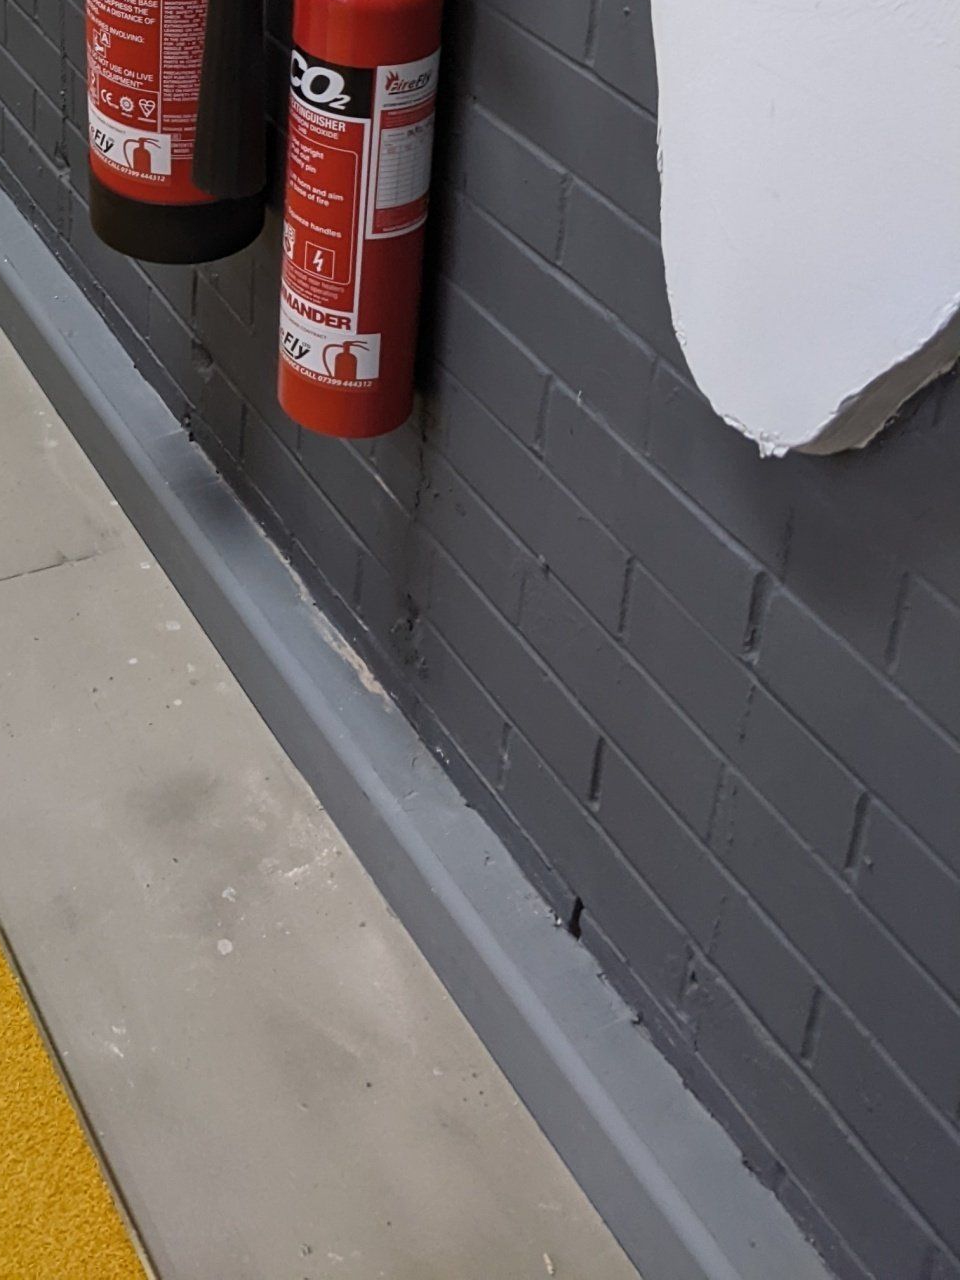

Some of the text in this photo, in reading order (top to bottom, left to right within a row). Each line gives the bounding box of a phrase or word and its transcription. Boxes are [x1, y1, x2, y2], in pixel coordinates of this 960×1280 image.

[111, 9, 143, 23] DISTANCE
[133, 7, 149, 16] THE
[101, 32, 109, 43] A
[110, 63, 123, 74] USE
[123, 68, 135, 78] ON
[136, 72, 154, 82] LIVE
[309, 123, 339, 140] DIOXIDE
[300, 143, 324, 160] upright
[305, 164, 317, 174] pin
[297, 177, 311, 191] horn
[312, 187, 327, 197] and
[328, 192, 344, 202] aim
[307, 193, 315, 201] of
[316, 196, 330, 207] fire
[310, 222, 342, 238] handles
[299, 367, 317, 380] CALL
